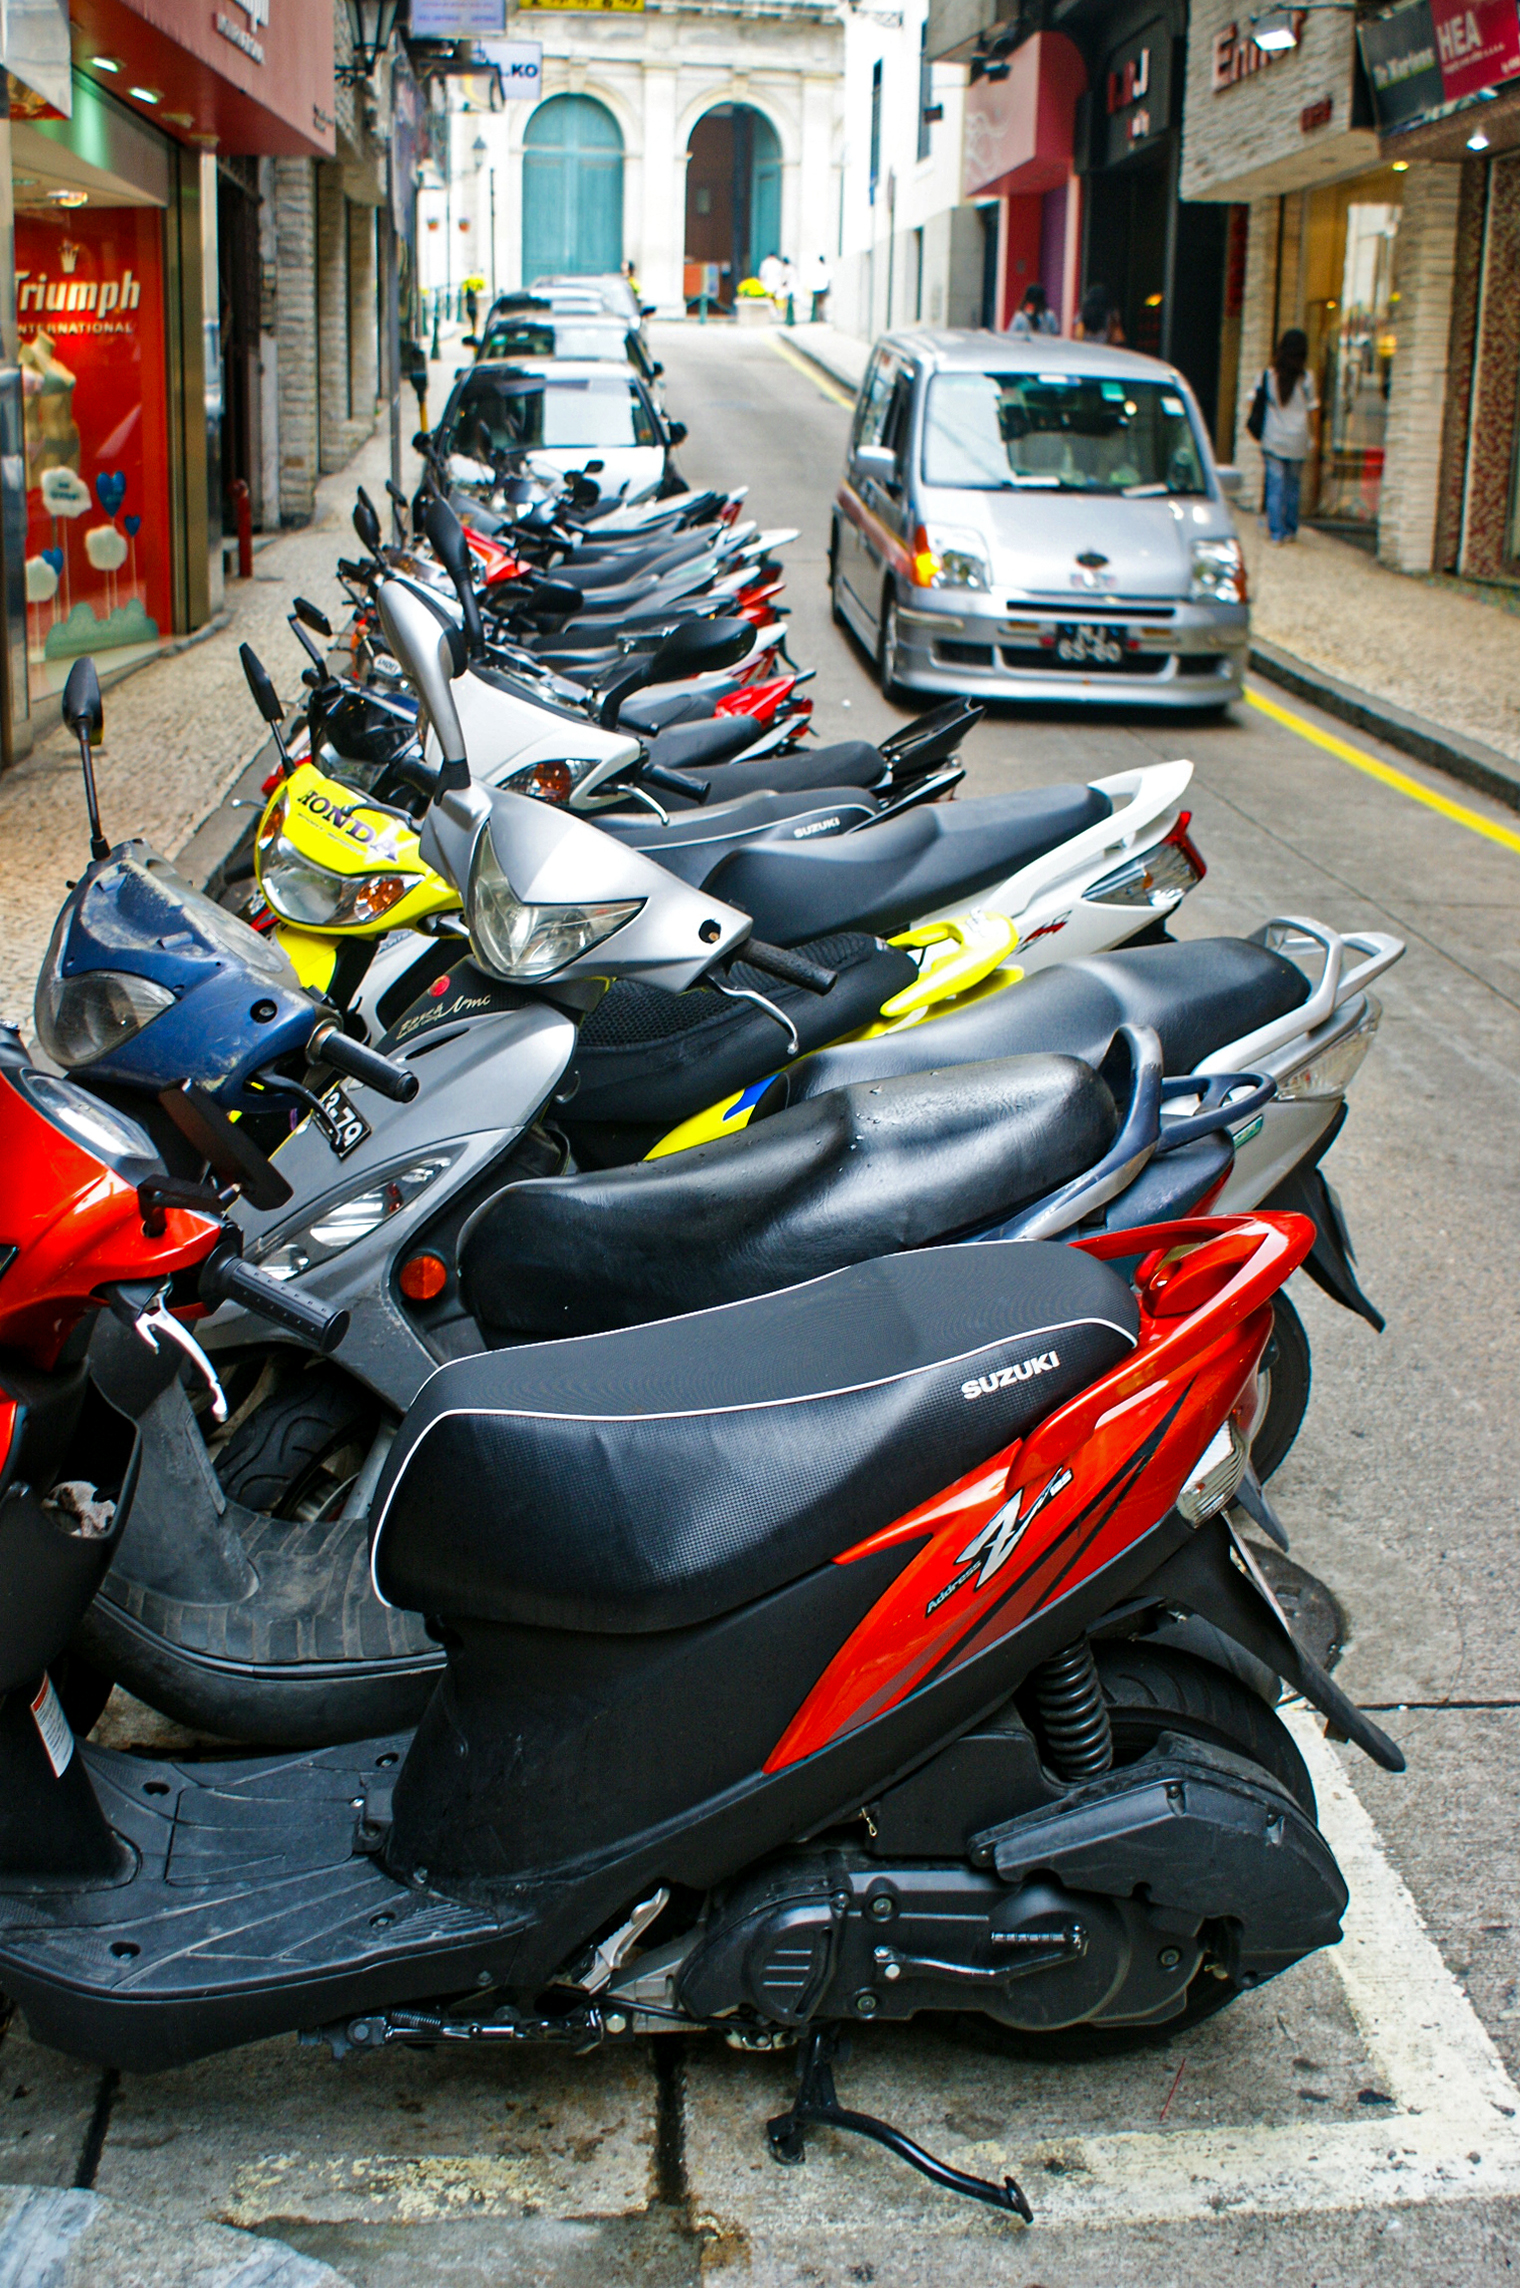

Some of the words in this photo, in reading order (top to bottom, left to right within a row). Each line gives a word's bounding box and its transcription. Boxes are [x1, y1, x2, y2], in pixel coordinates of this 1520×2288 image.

[793, 816, 841, 839] SUZUKI
[961, 1350, 1060, 1400] SUZUKI
[926, 1559, 982, 1615] Address
